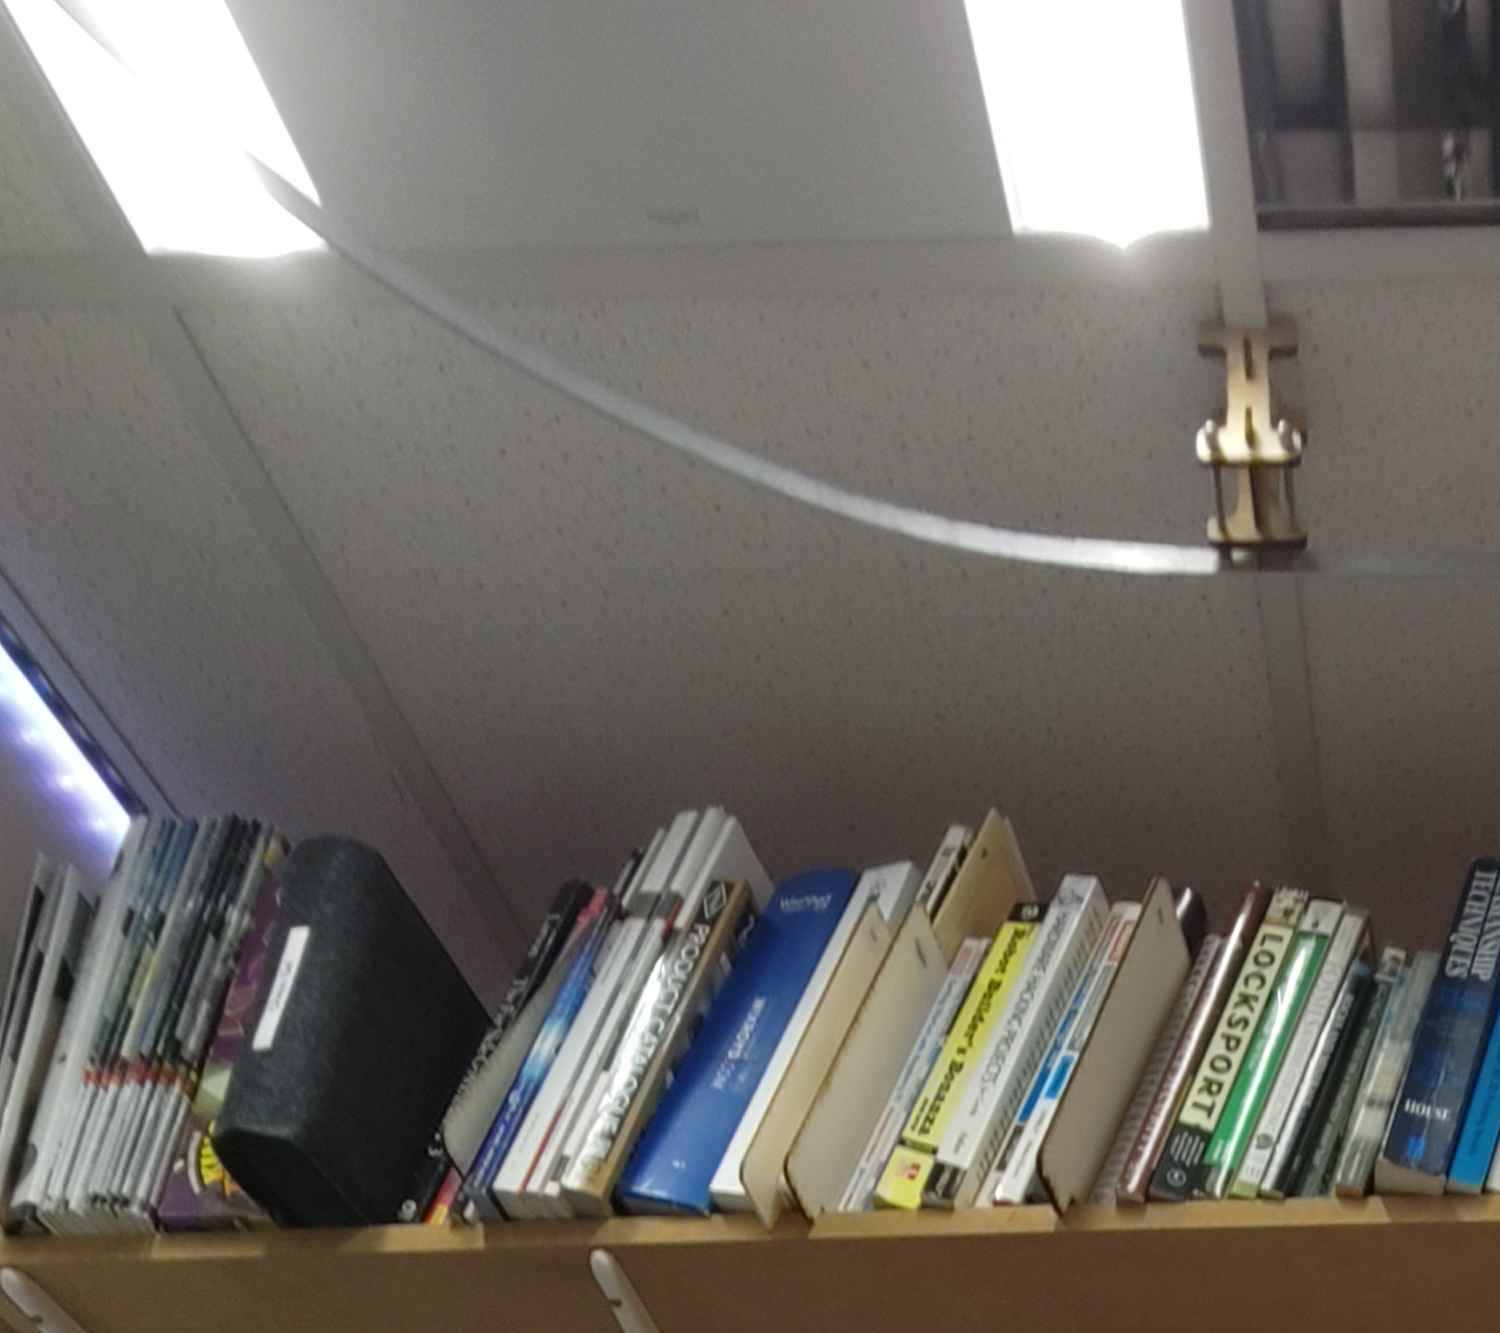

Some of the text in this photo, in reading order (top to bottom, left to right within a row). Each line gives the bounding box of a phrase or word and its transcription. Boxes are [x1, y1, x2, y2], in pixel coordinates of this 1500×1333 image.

[1445, 868, 1498, 981] TECHNIQUES
[1185, 929, 1287, 1117] LOCKSPORT
[912, 1057, 966, 1138] Bonanza
